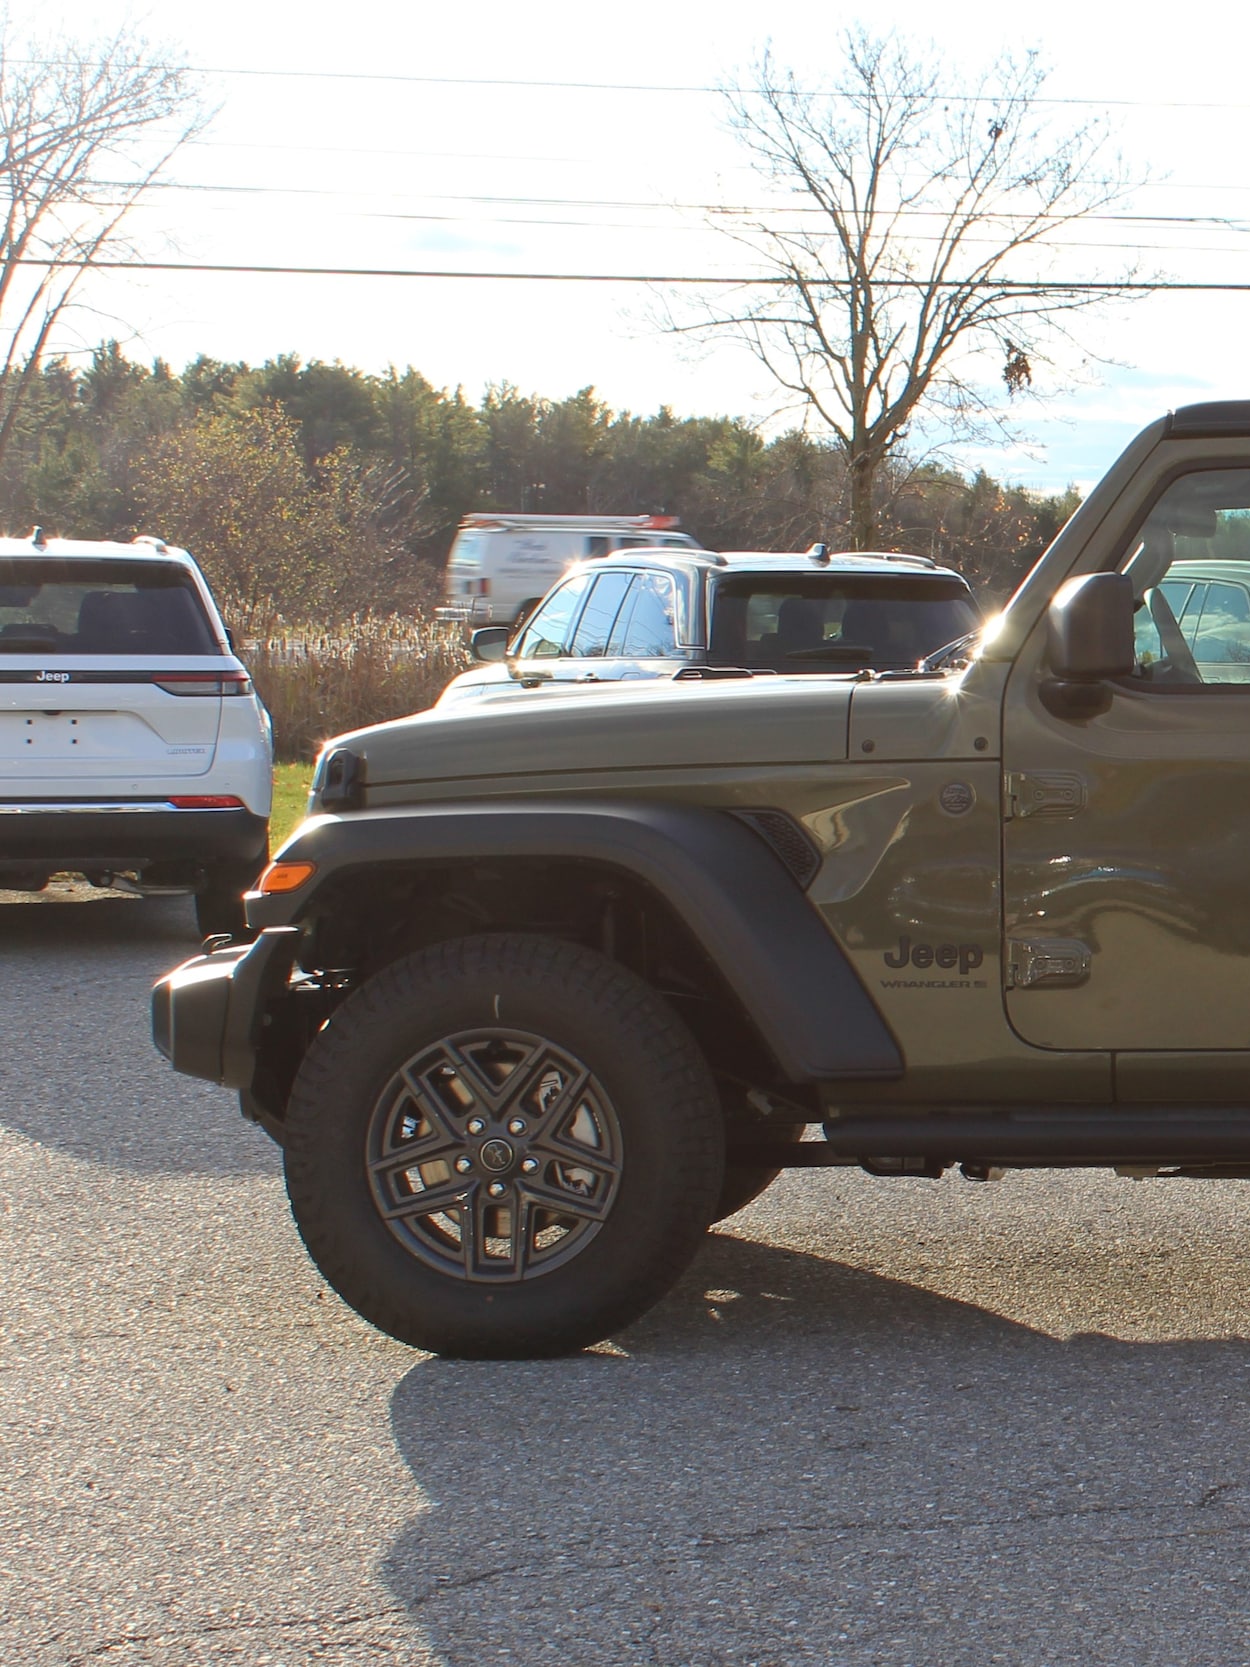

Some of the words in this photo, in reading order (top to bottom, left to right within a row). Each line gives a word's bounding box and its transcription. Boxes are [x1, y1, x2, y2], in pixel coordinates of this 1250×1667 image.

[36, 670, 71, 683] Jeep
[884, 935, 984, 975] Jeep
[880, 980, 970, 989] WRANGLER
